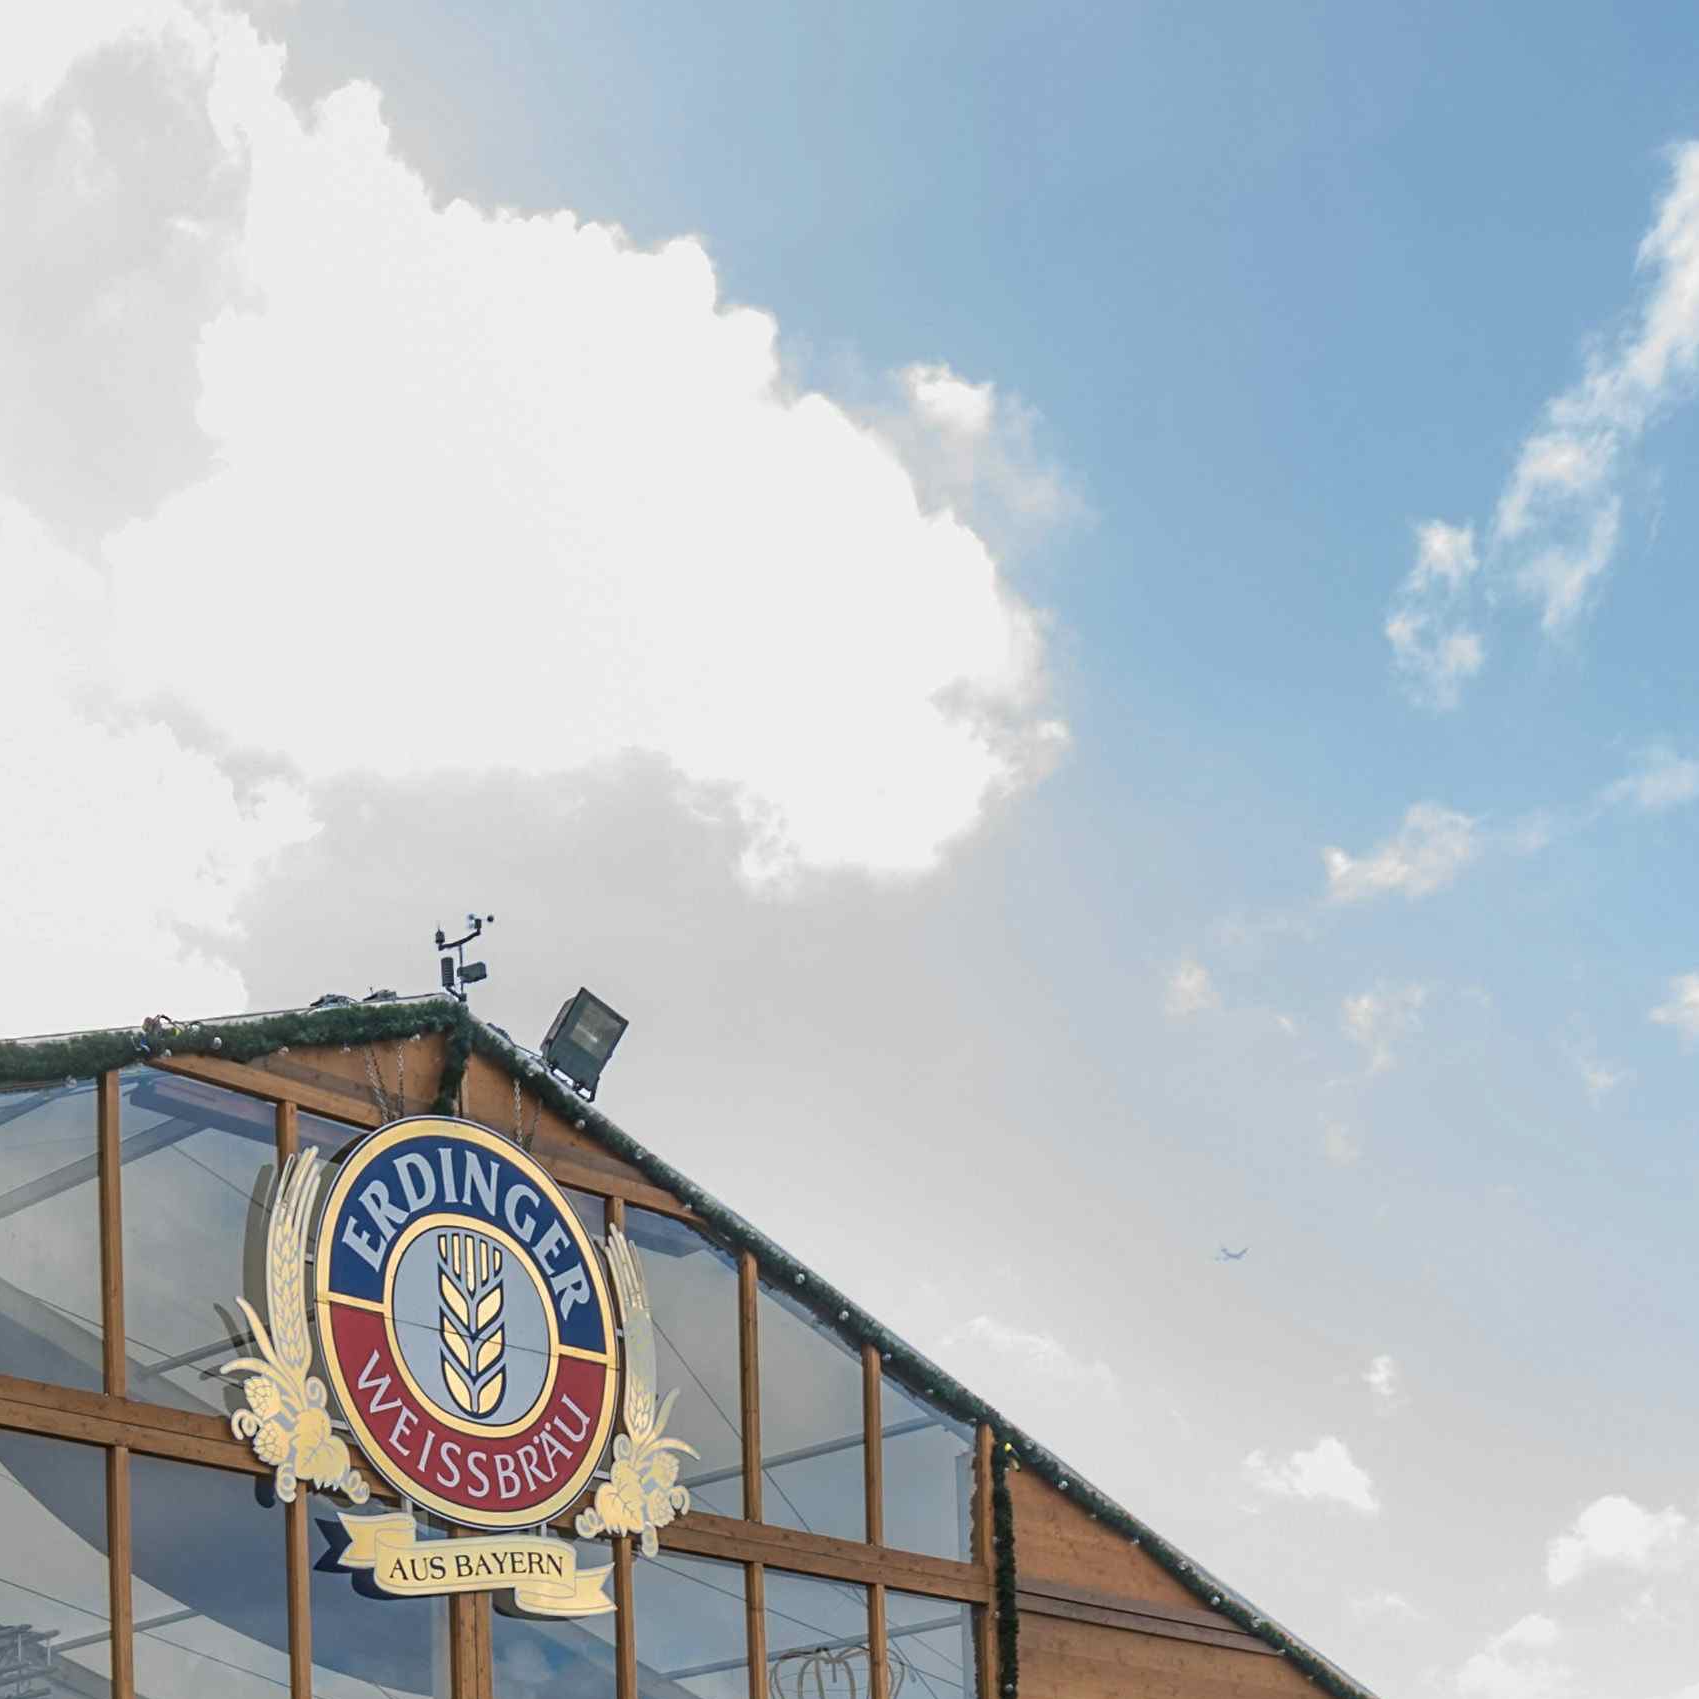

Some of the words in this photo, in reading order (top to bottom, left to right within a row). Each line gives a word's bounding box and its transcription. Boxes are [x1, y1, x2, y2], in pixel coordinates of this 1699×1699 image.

[342, 1146, 592, 1322] ERDINGER
[357, 1349, 591, 1500] WEISSBRÄU
[388, 1557, 447, 1583] AUS
[455, 1551, 565, 1579] BAYERN
